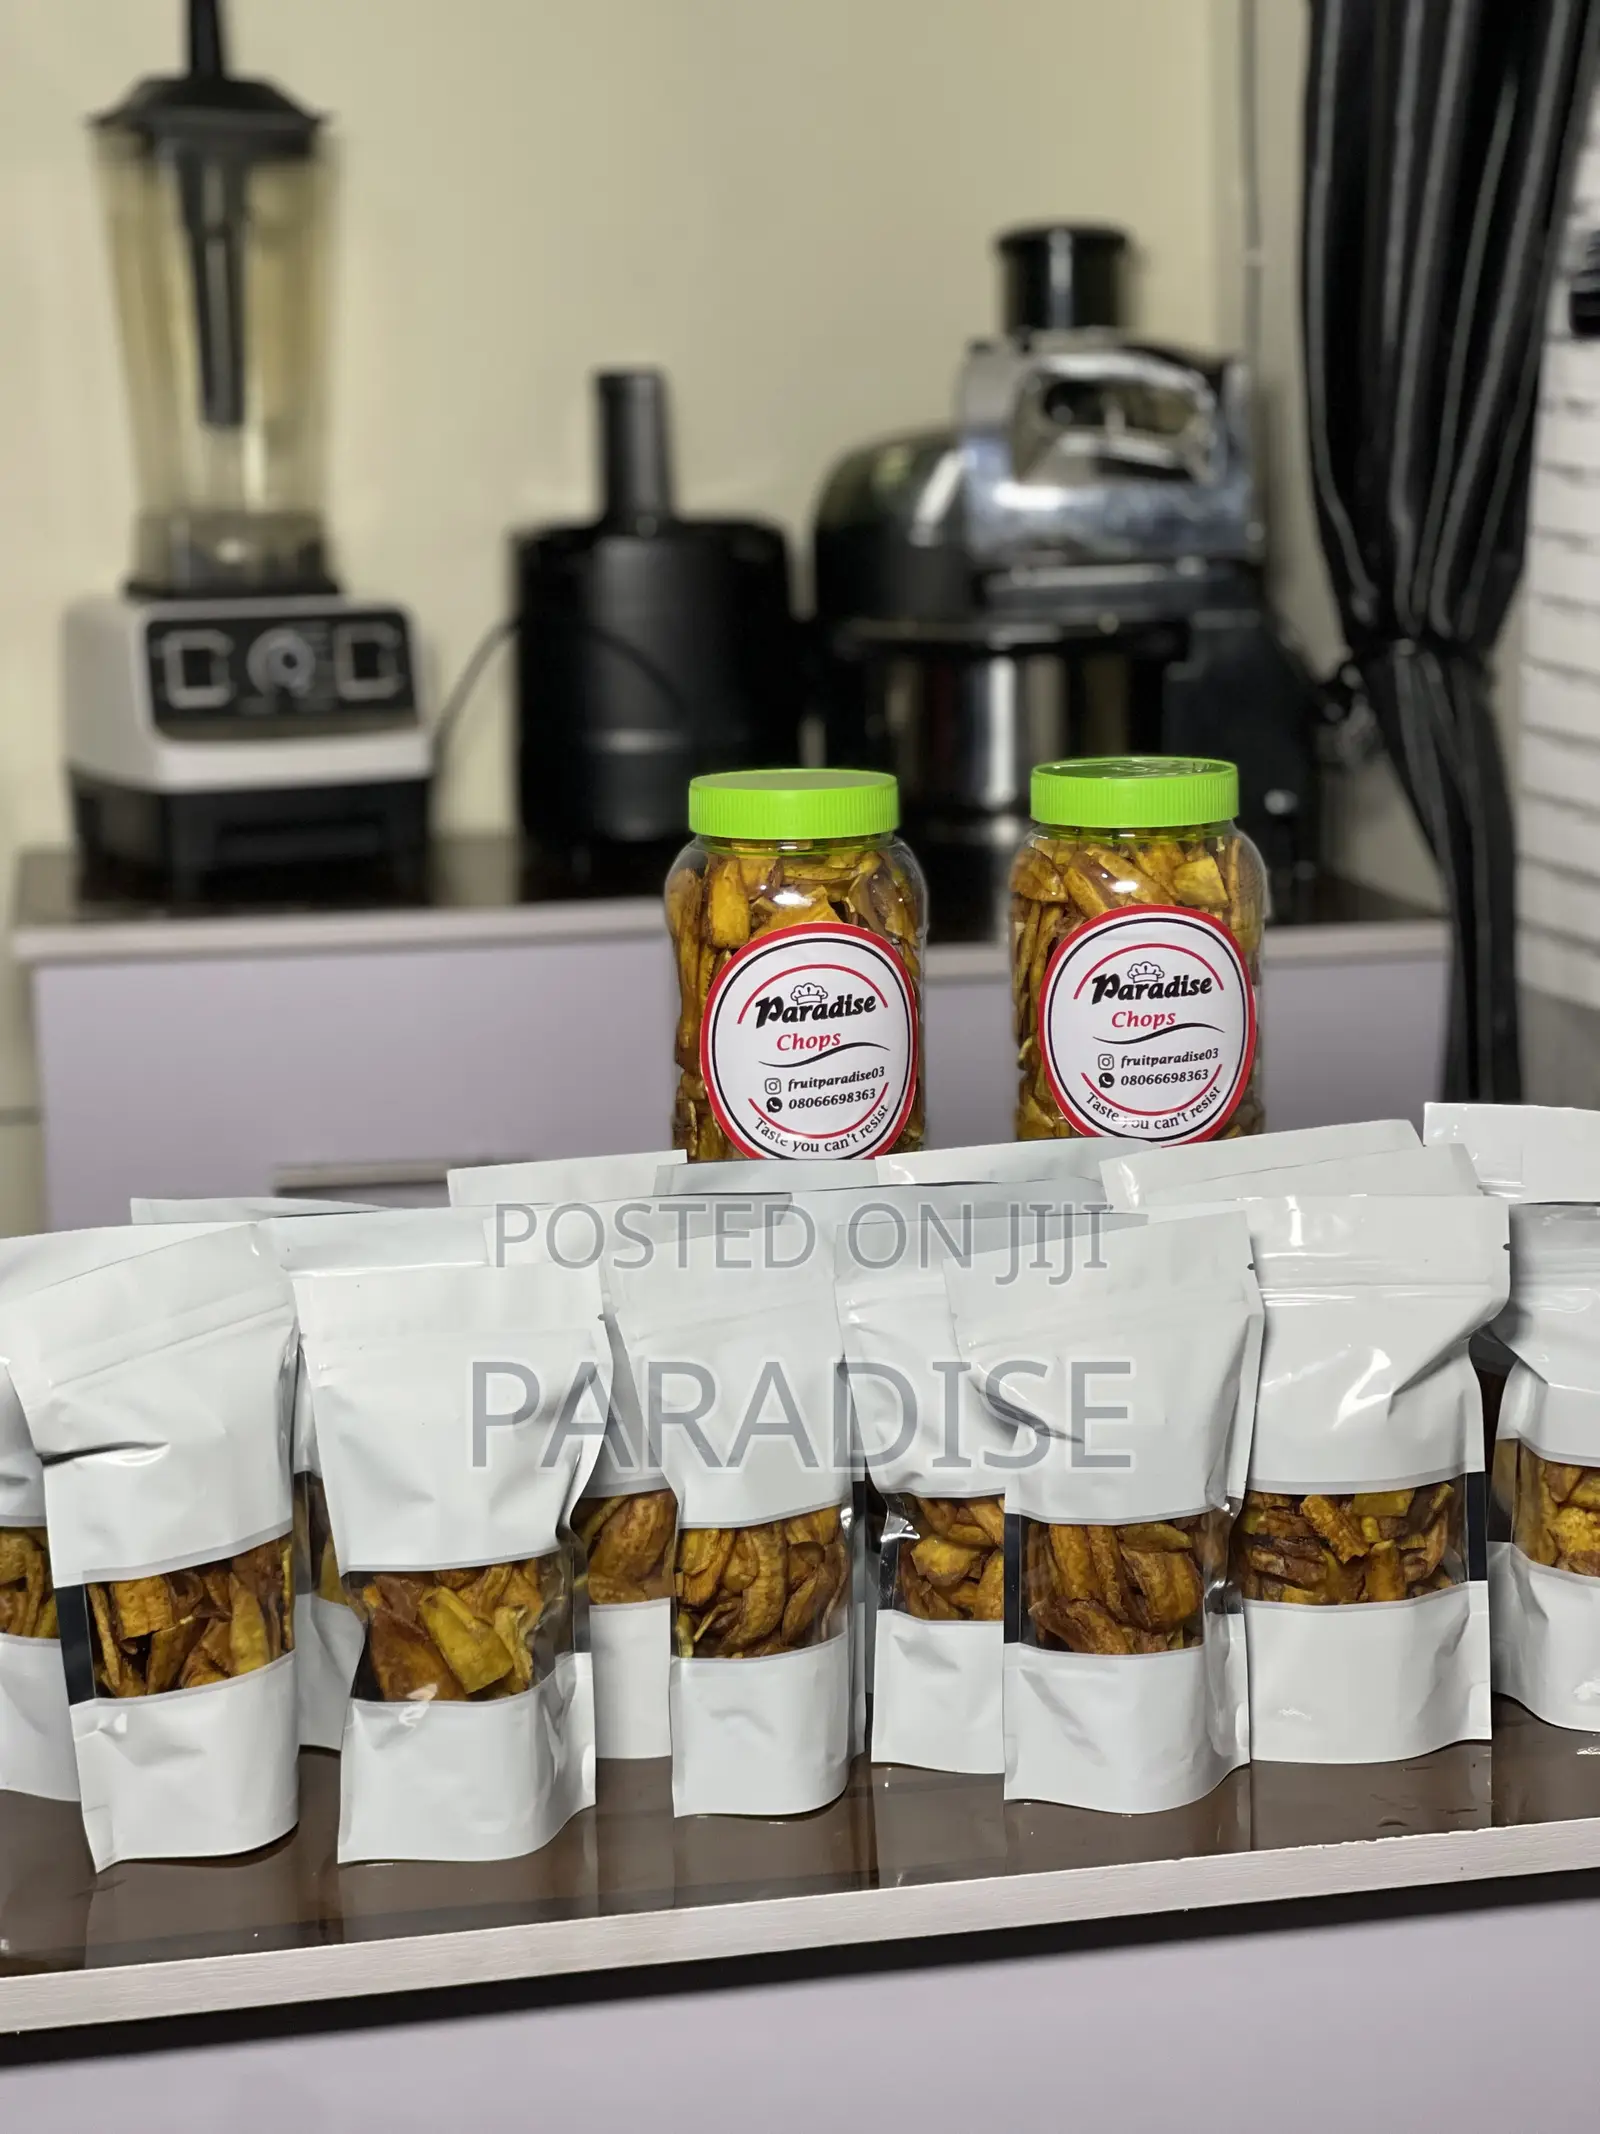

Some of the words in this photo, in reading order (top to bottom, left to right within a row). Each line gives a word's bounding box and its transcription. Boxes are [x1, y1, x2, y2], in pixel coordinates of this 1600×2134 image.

[1091, 973, 1212, 1004] Paradise
[755, 994, 876, 1028] Paradise
[1111, 1010, 1177, 1030] Chops
[776, 1032, 842, 1052] Chops
[1120, 1047, 1219, 1068] fruitparadise03
[788, 1066, 886, 1092] fruitparadise03
[1120, 1069, 1209, 1086] 08066698363
[788, 1088, 876, 1110] 08066698363
[1085, 1092, 1120, 1123] Taste
[1154, 1111, 1189, 1130] can't
[1189, 1086, 1222, 1119] resist
[754, 1117, 789, 1147] Taste
[791, 1139, 820, 1154] you
[824, 1133, 858, 1152] can't
[860, 1103, 890, 1138] resist
